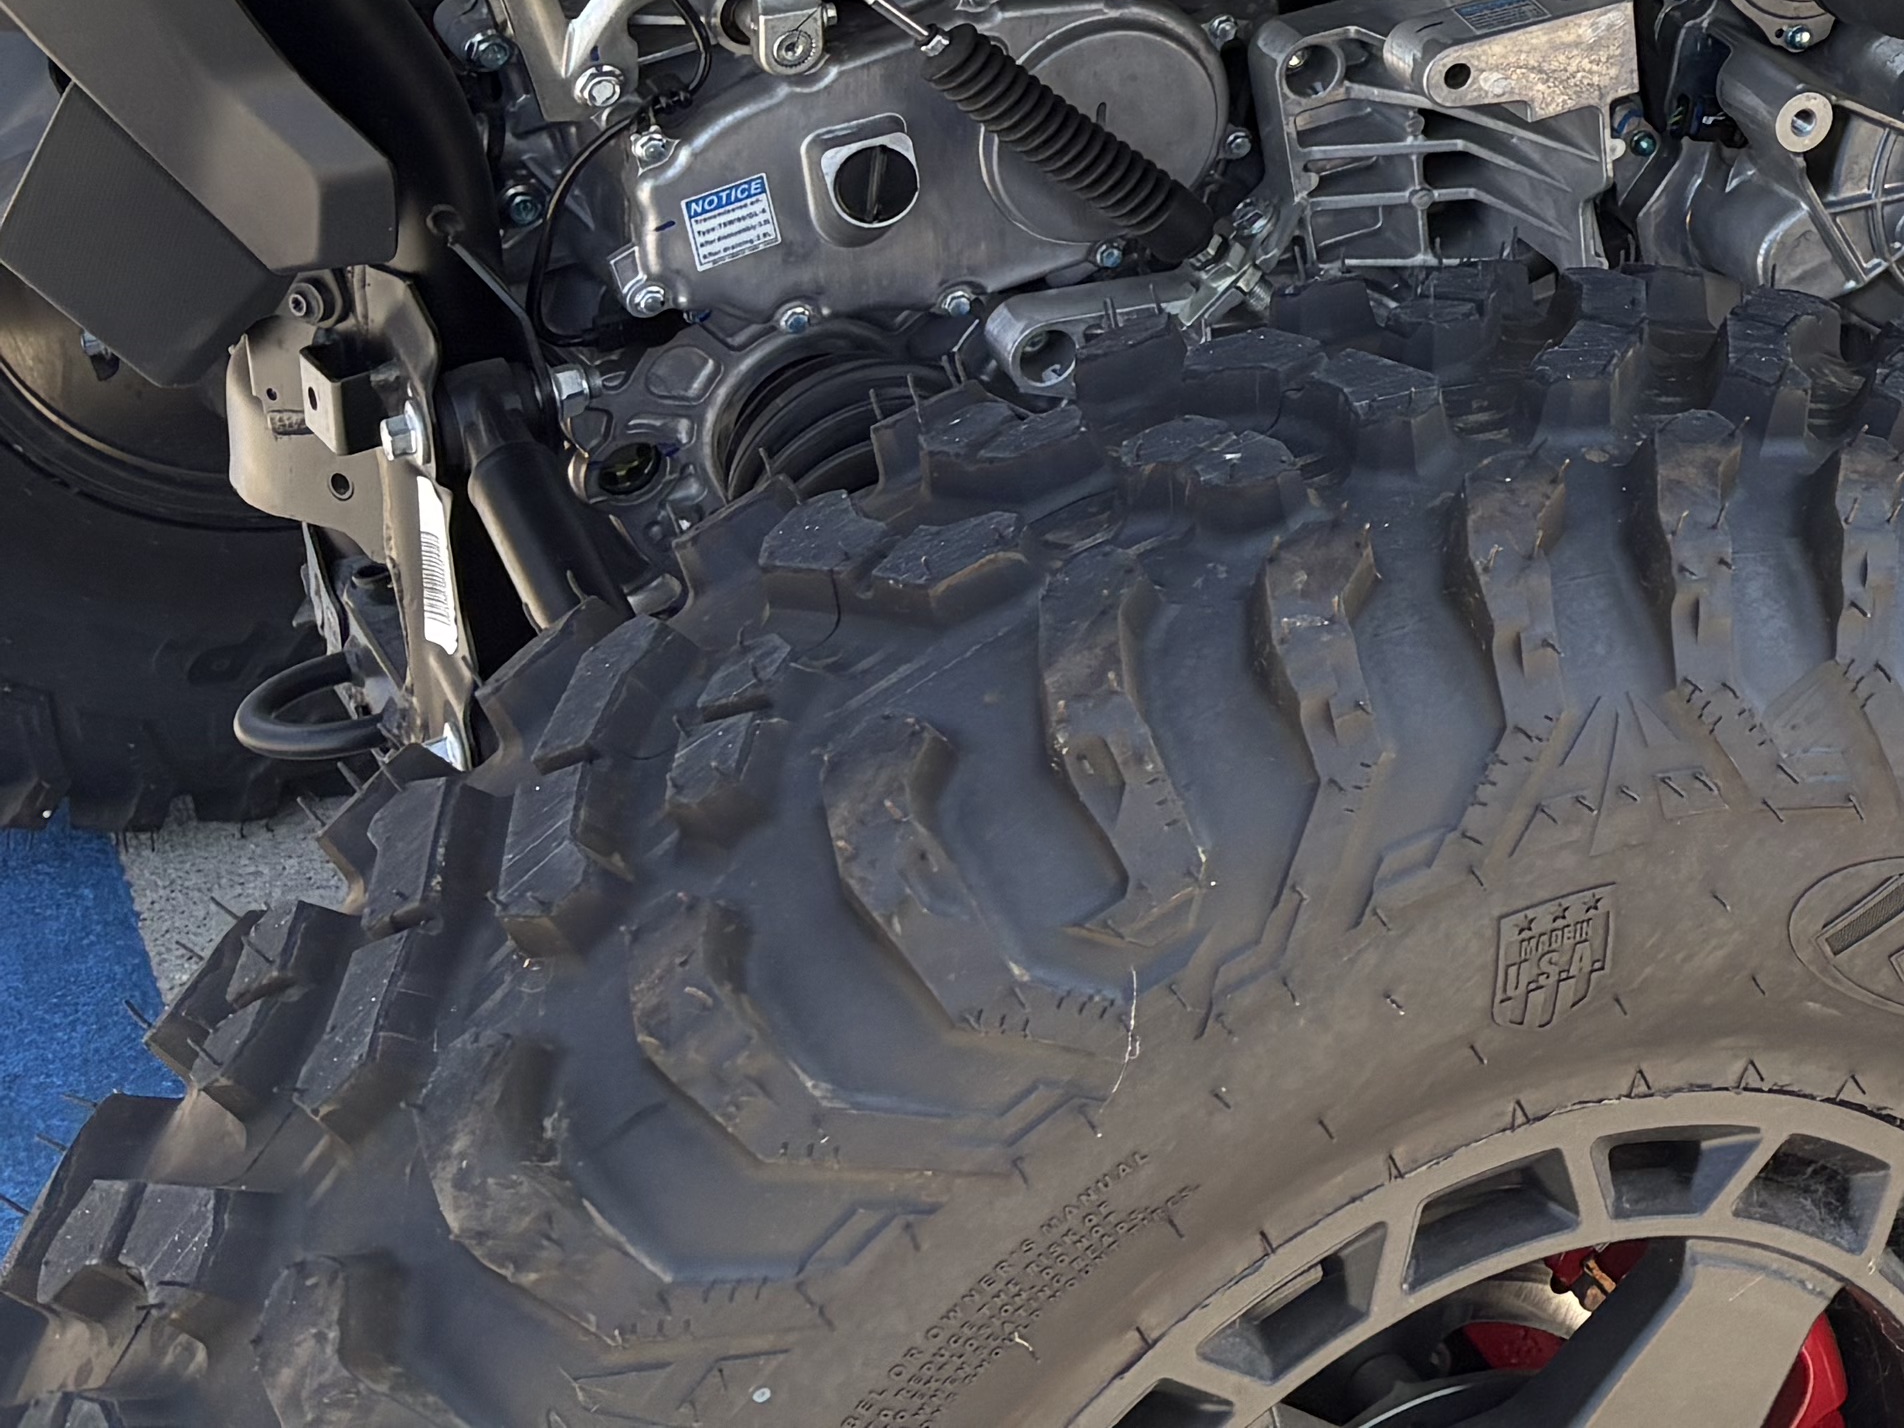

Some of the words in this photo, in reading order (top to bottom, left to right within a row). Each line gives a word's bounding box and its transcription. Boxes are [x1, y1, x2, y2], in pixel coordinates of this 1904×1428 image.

[690, 179, 763, 217] NOTICE
[1519, 924, 1572, 959] MADE
[887, 1344, 922, 1380] OR
[924, 1237, 1035, 1342] OWNER'S
[1040, 1147, 1149, 1236] MANUAL
